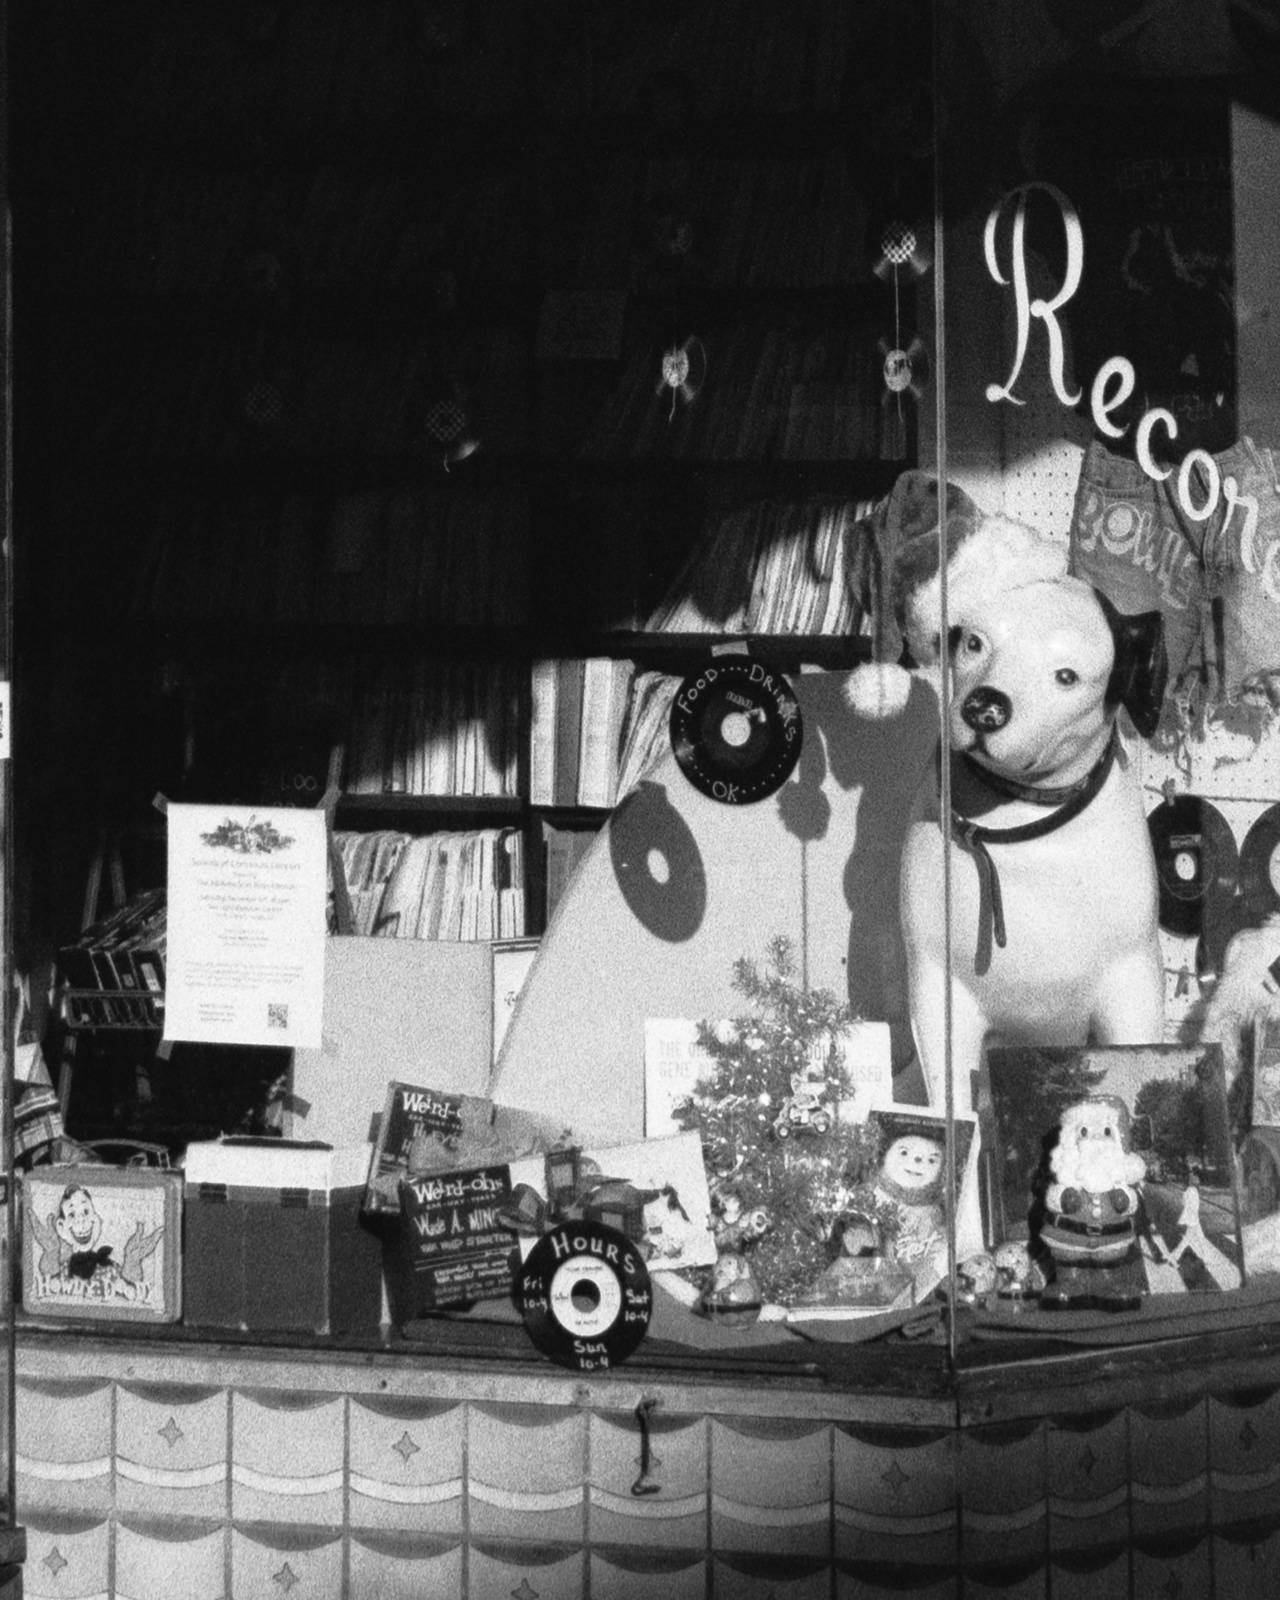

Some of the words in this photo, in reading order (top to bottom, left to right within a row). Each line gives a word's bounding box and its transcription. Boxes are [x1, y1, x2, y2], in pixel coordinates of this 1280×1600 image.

[677, 667, 719, 715] FOOD
[748, 663, 799, 743] DRINKS
[711, 780, 741, 803] OK
[522, 1276, 543, 1292] Fri
[625, 1288, 650, 1305] Sat
[523, 1298, 549, 1314] 10-4
[624, 1310, 649, 1323] 10-4
[572, 1339, 608, 1354] Sun
[578, 1357, 610, 1370] 10-4
